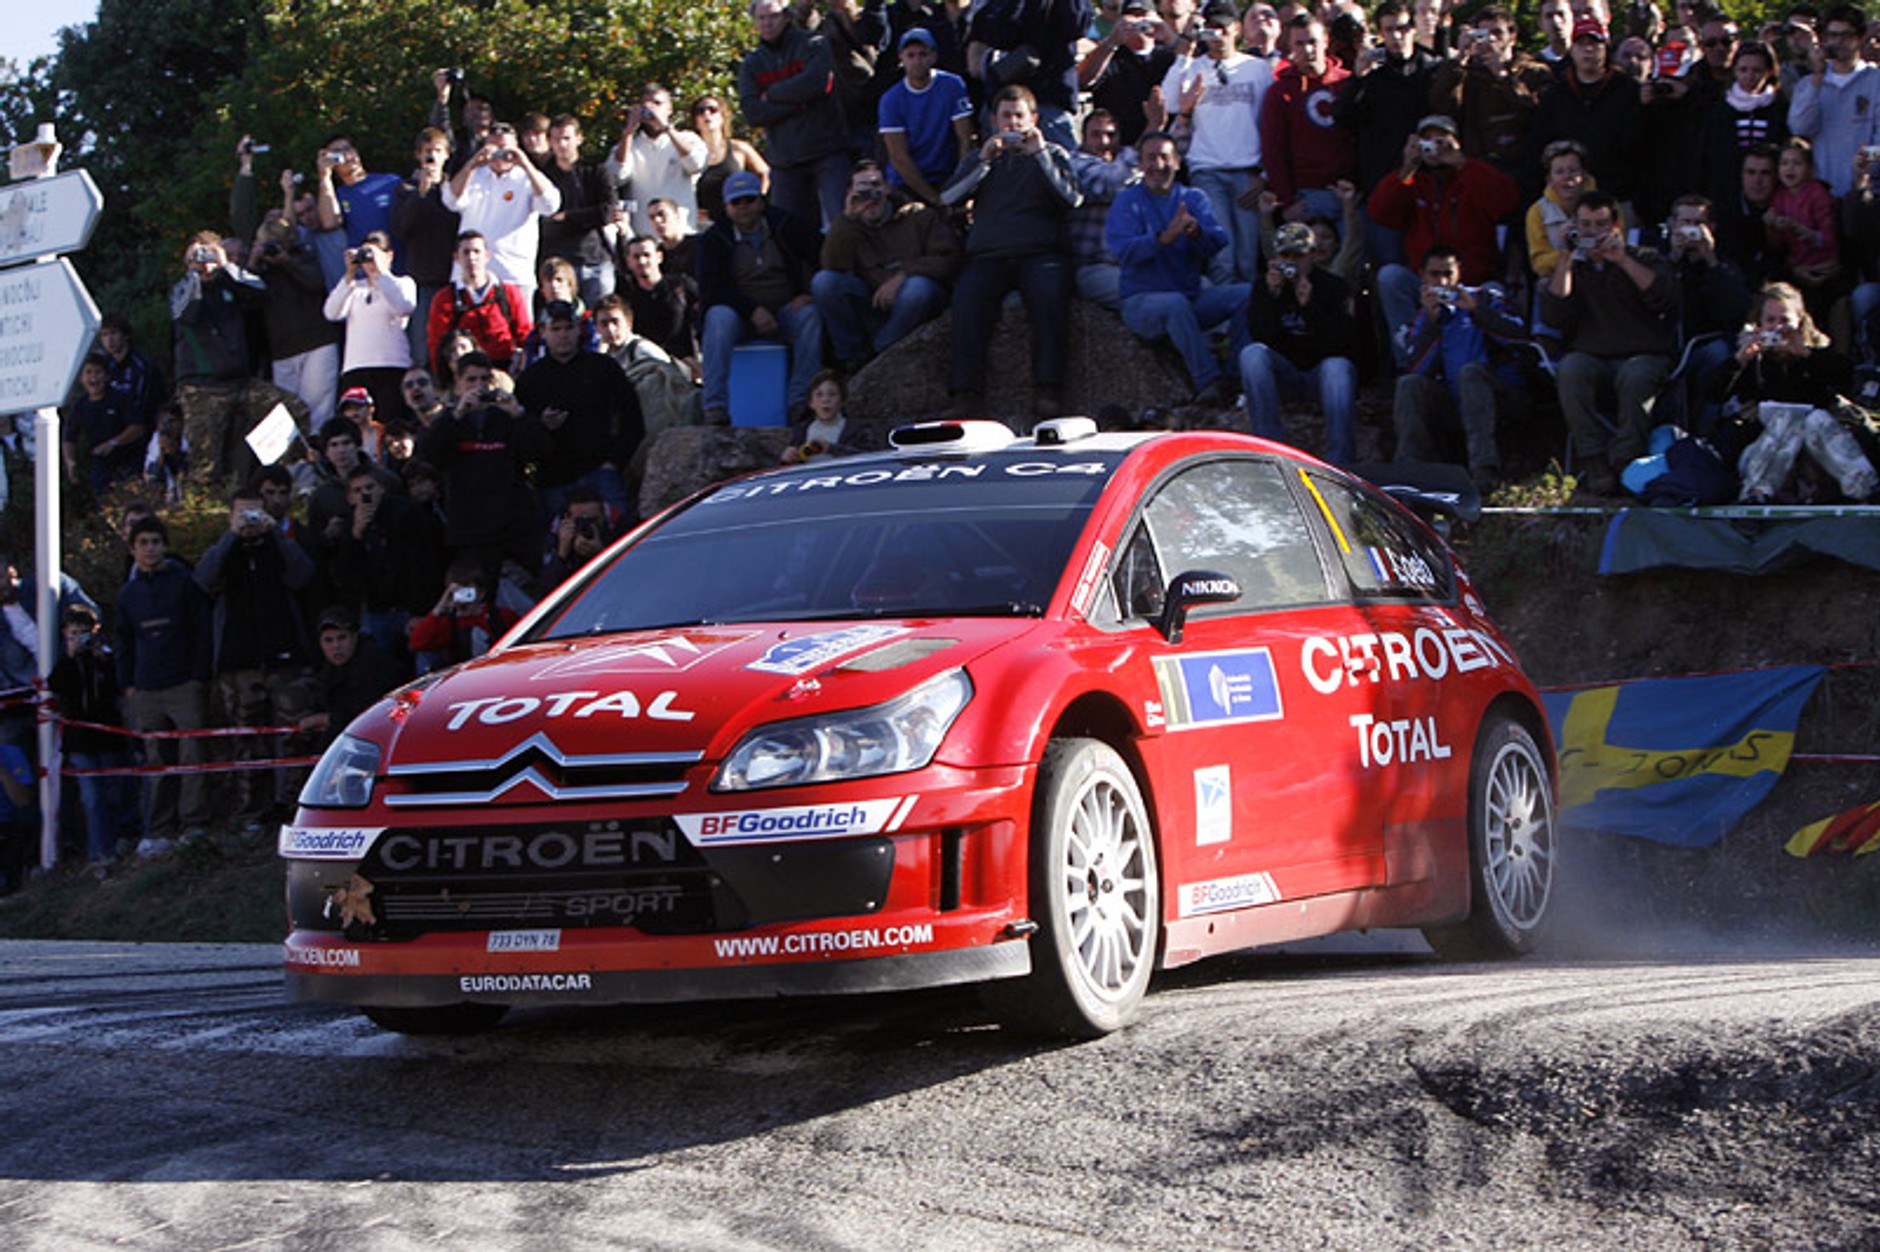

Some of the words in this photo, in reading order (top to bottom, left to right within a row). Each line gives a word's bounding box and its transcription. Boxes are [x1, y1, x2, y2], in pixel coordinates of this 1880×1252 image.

[702, 463, 986, 504] CITROËN
[1005, 461, 1107, 476] C4
[447, 690, 696, 731] TOTAL
[1349, 714, 1452, 769] TOTAL
[699, 806, 867, 836] BFGoodrich
[379, 819, 677, 871] CITROËN
[565, 892, 683, 916] SPORT
[713, 924, 935, 959] WWW.CITROEN.COM
[460, 974, 593, 993] EURODATACAR
